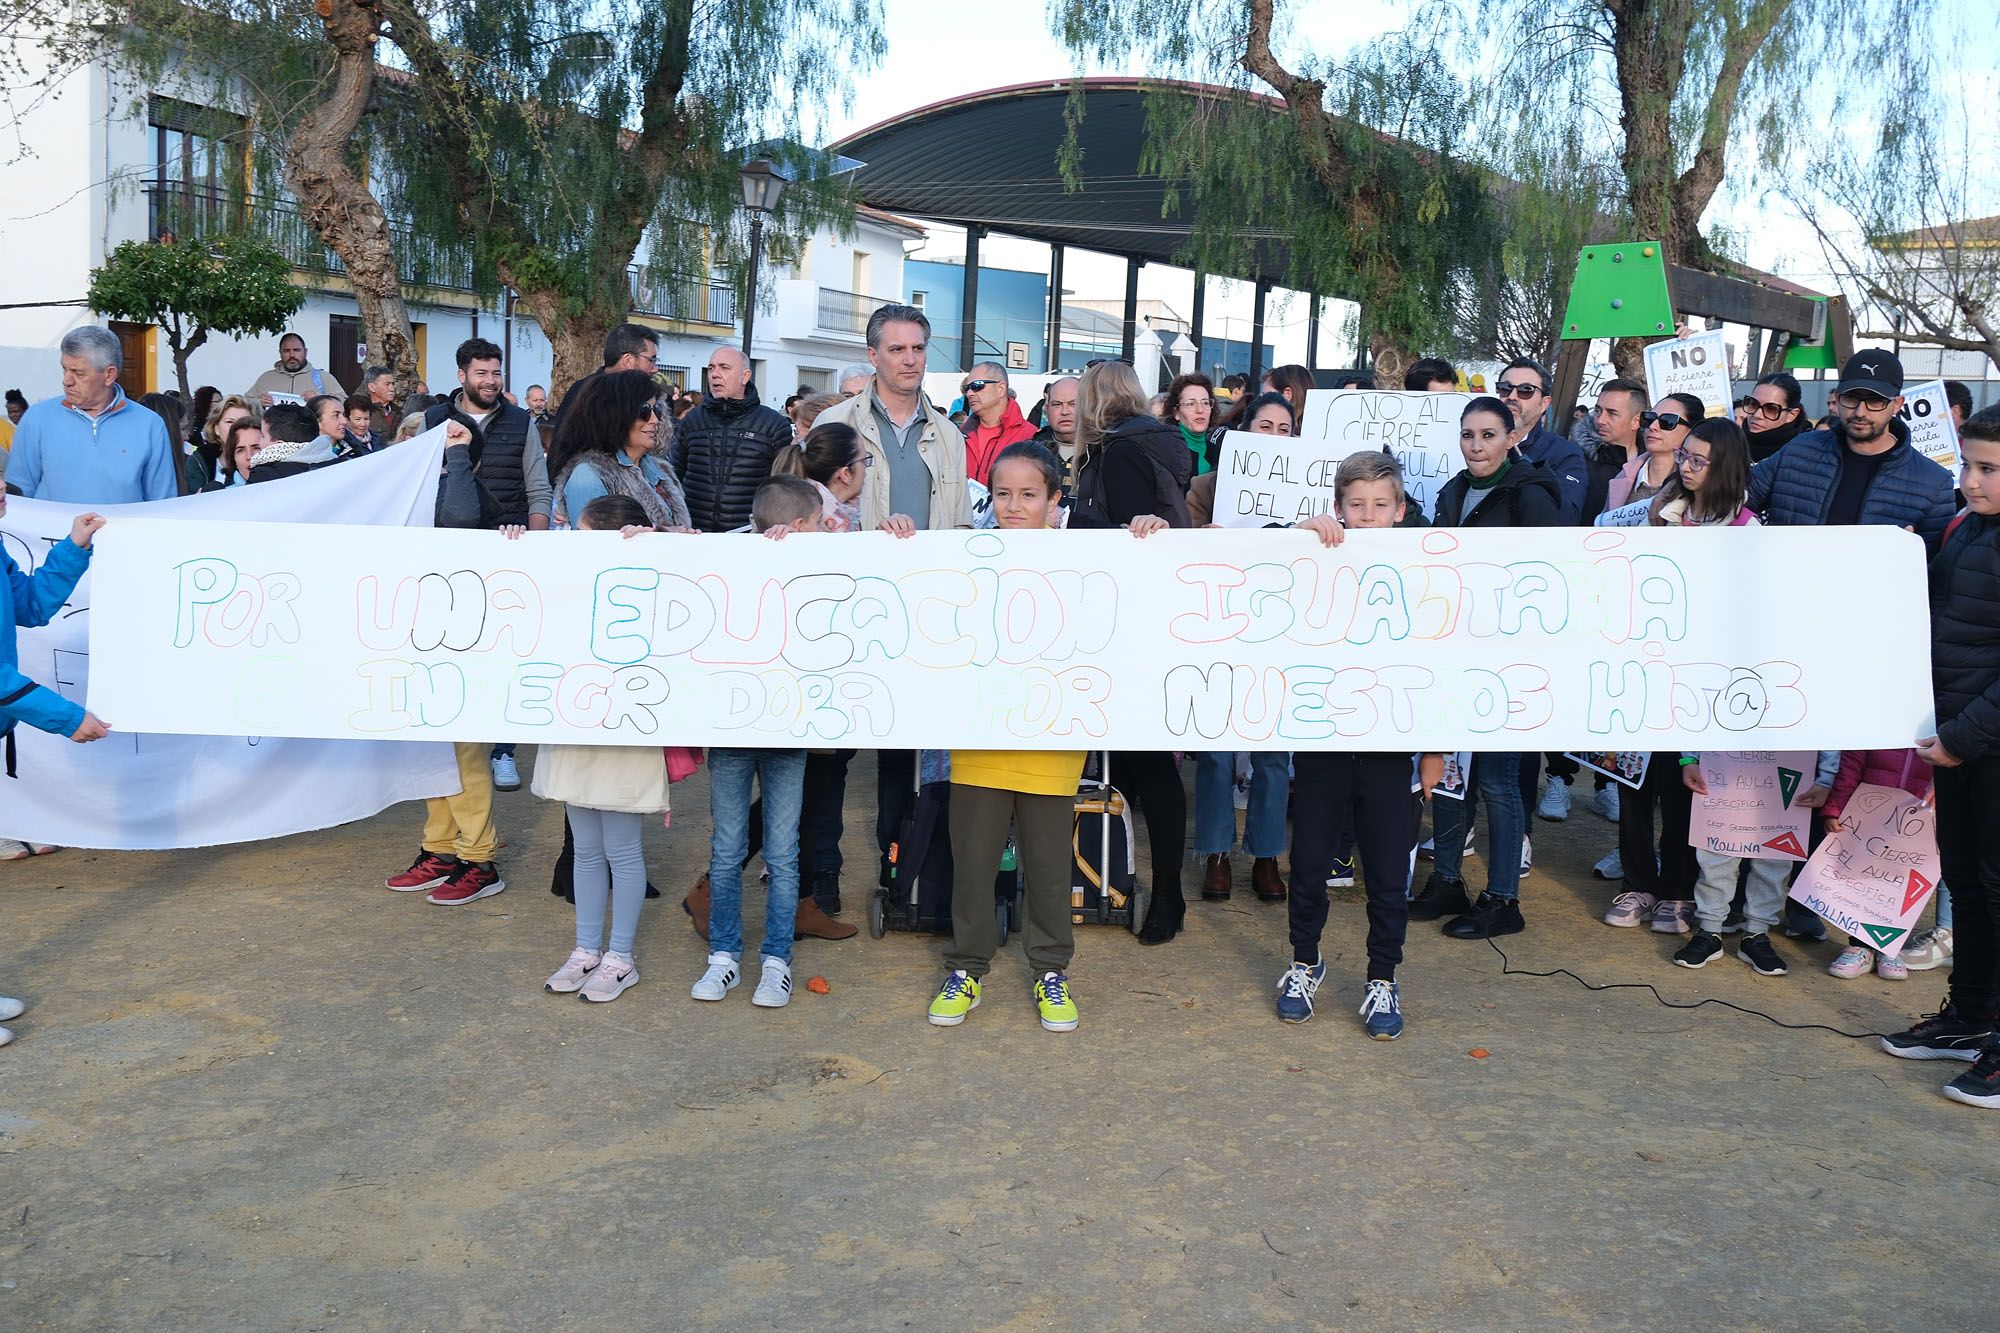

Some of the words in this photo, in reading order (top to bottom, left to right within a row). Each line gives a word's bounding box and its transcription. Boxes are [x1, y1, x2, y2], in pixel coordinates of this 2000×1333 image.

[1670, 346, 1707, 370] NO
[1681, 370, 1714, 381] cierre
[1687, 380, 1716, 392] Aula
[1360, 395, 1404, 420] NO
[1418, 397, 1449, 423] AL
[1232, 449, 1262, 478] NO
[1268, 454, 1299, 485] AL
[1306, 459, 1343, 488] CIE
[1237, 489, 1285, 520] DEL
[172, 557, 302, 648] POR
[356, 569, 544, 658] UNA
[230, 655, 304, 729] E
[972, 665, 1113, 738] POR
[1163, 662, 1552, 741] NUESTROS
[1707, 769, 1729, 786] DEL
[1735, 775, 1773, 788] AULA
[1840, 815, 1862, 841] AL
[1885, 806, 1925, 837] NO
[1825, 836, 1854, 871] DEL
[1861, 865, 1906, 888] AULA
